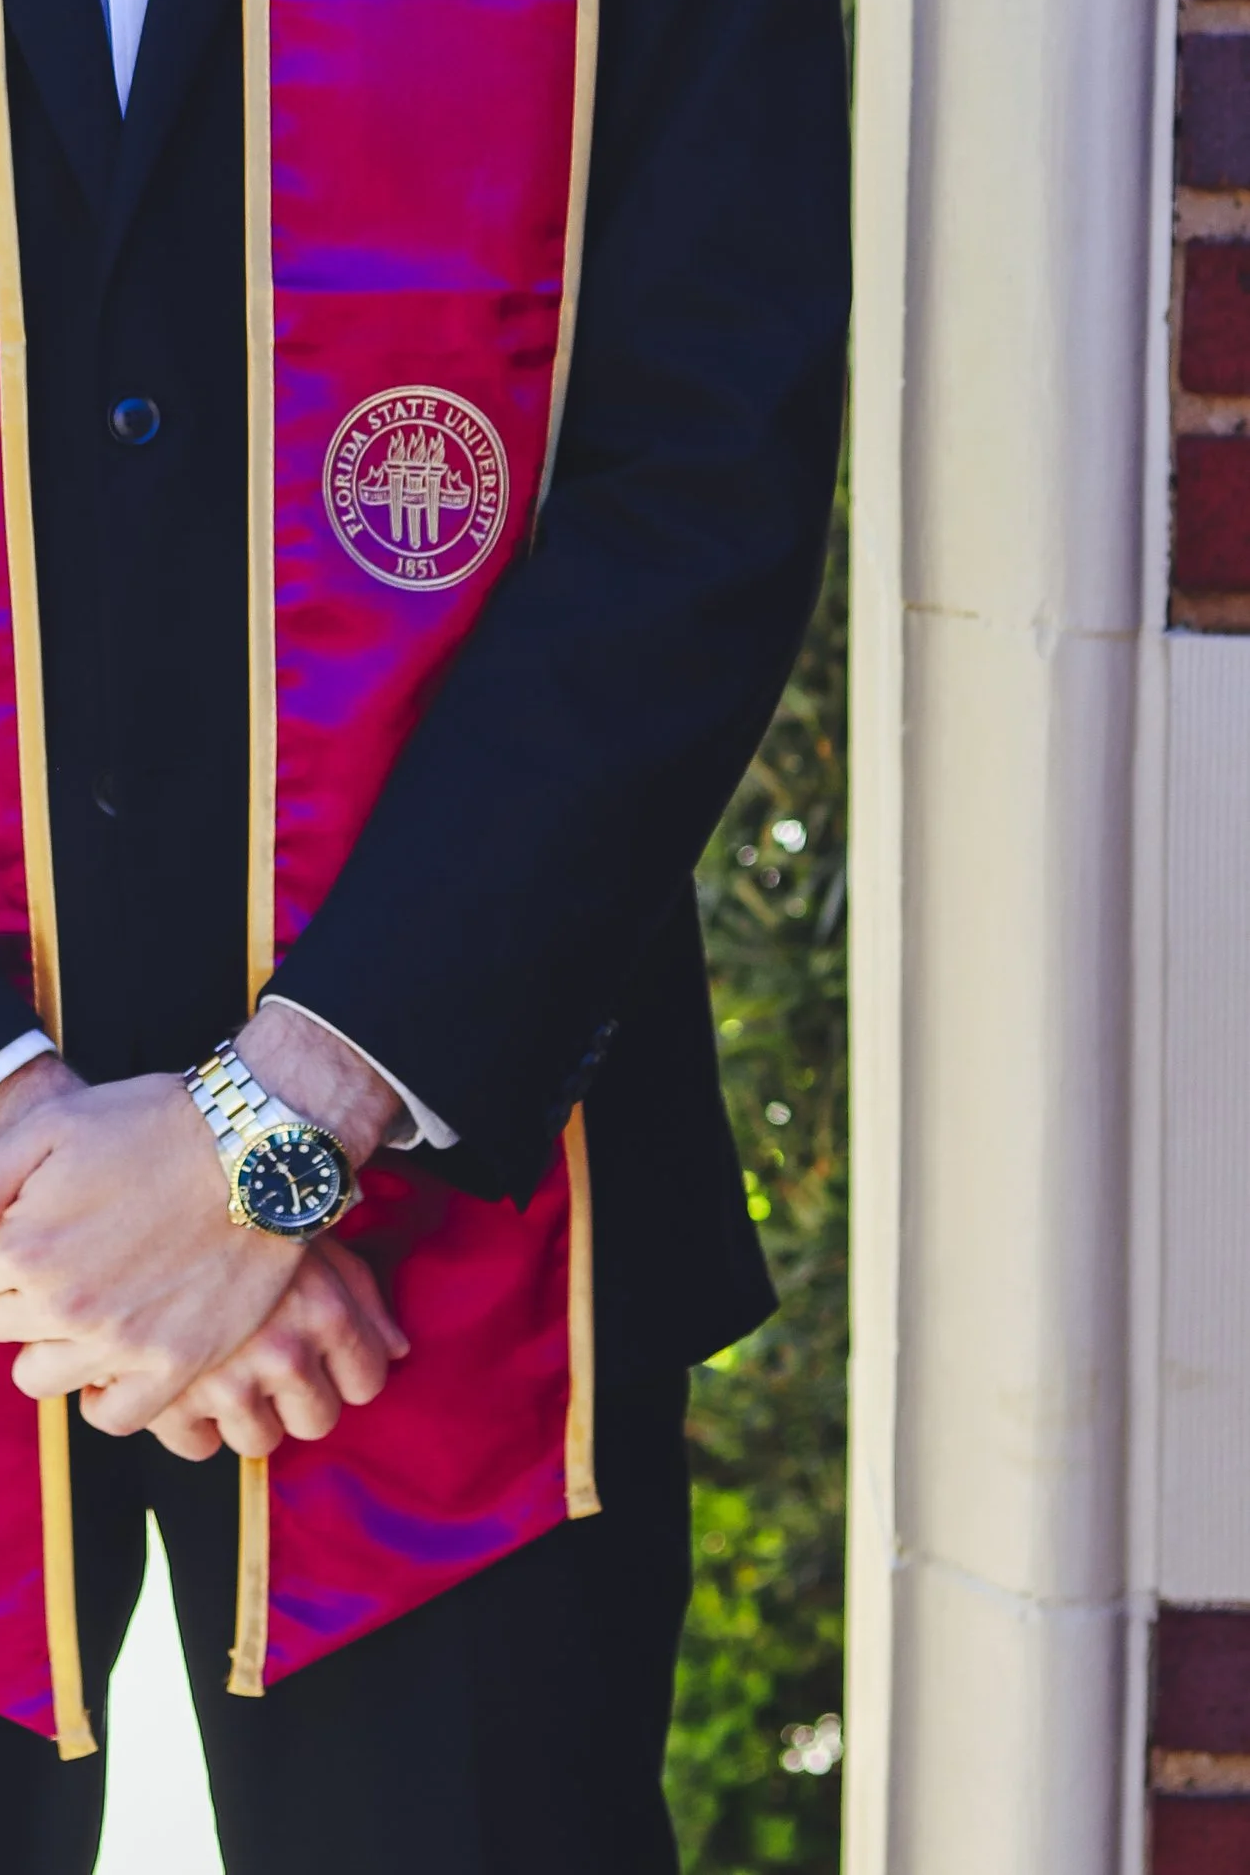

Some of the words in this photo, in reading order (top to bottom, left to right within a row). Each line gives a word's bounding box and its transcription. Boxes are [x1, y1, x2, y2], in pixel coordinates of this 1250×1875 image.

[334, 429, 369, 539] FLORIDA
[367, 398, 438, 430] STATE
[443, 407, 498, 548] UNIVERSITY
[395, 557, 440, 578] 1851
